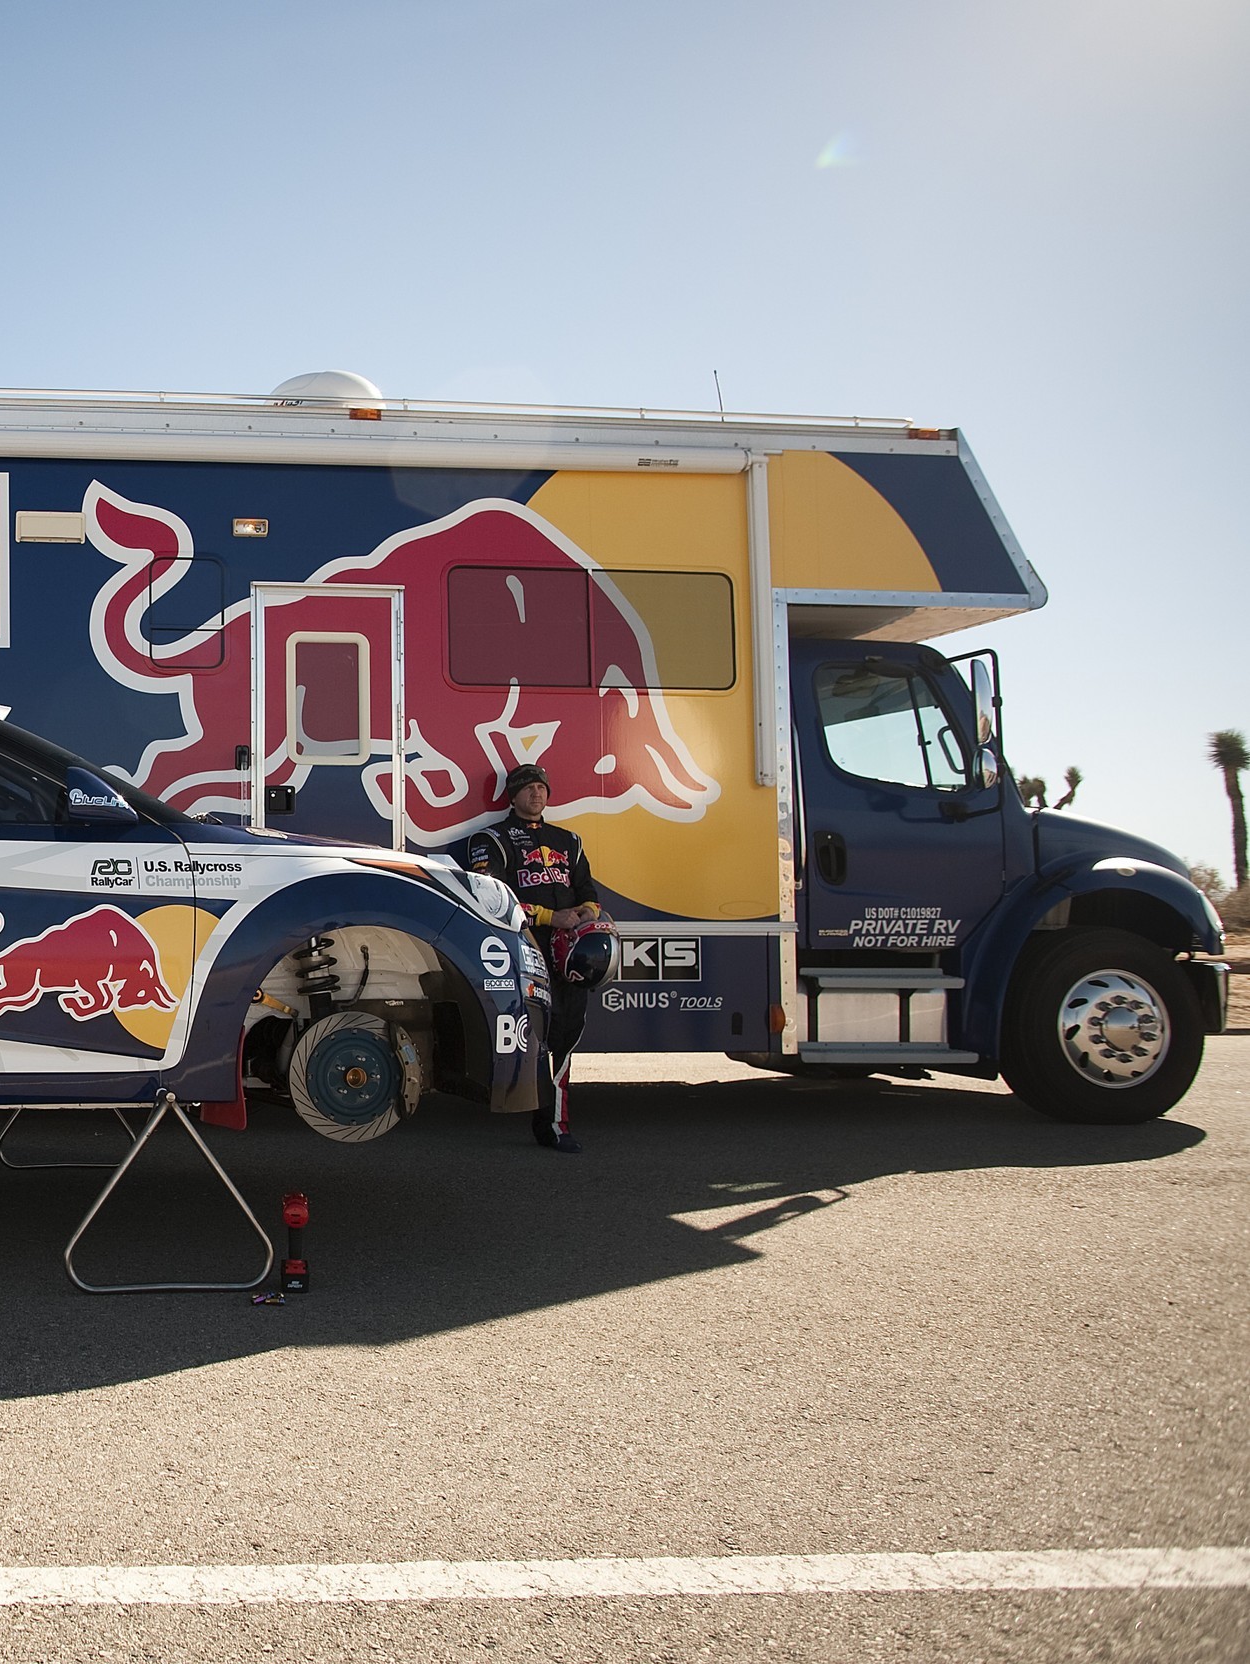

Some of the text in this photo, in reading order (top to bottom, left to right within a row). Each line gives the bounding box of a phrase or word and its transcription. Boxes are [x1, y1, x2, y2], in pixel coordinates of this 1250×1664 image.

[144, 861, 242, 874] U.S. Rallycross
[145, 875, 241, 889] Championship
[517, 867, 554, 888] Red
[865, 908, 942, 919] US DOT# C1019827
[849, 920, 961, 934] PRIVATE RV
[853, 936, 956, 947] NOT FOR HIRE
[622, 941, 697, 967] KS
[485, 980, 514, 989] sparco
[680, 997, 723, 1009] TOOLS
